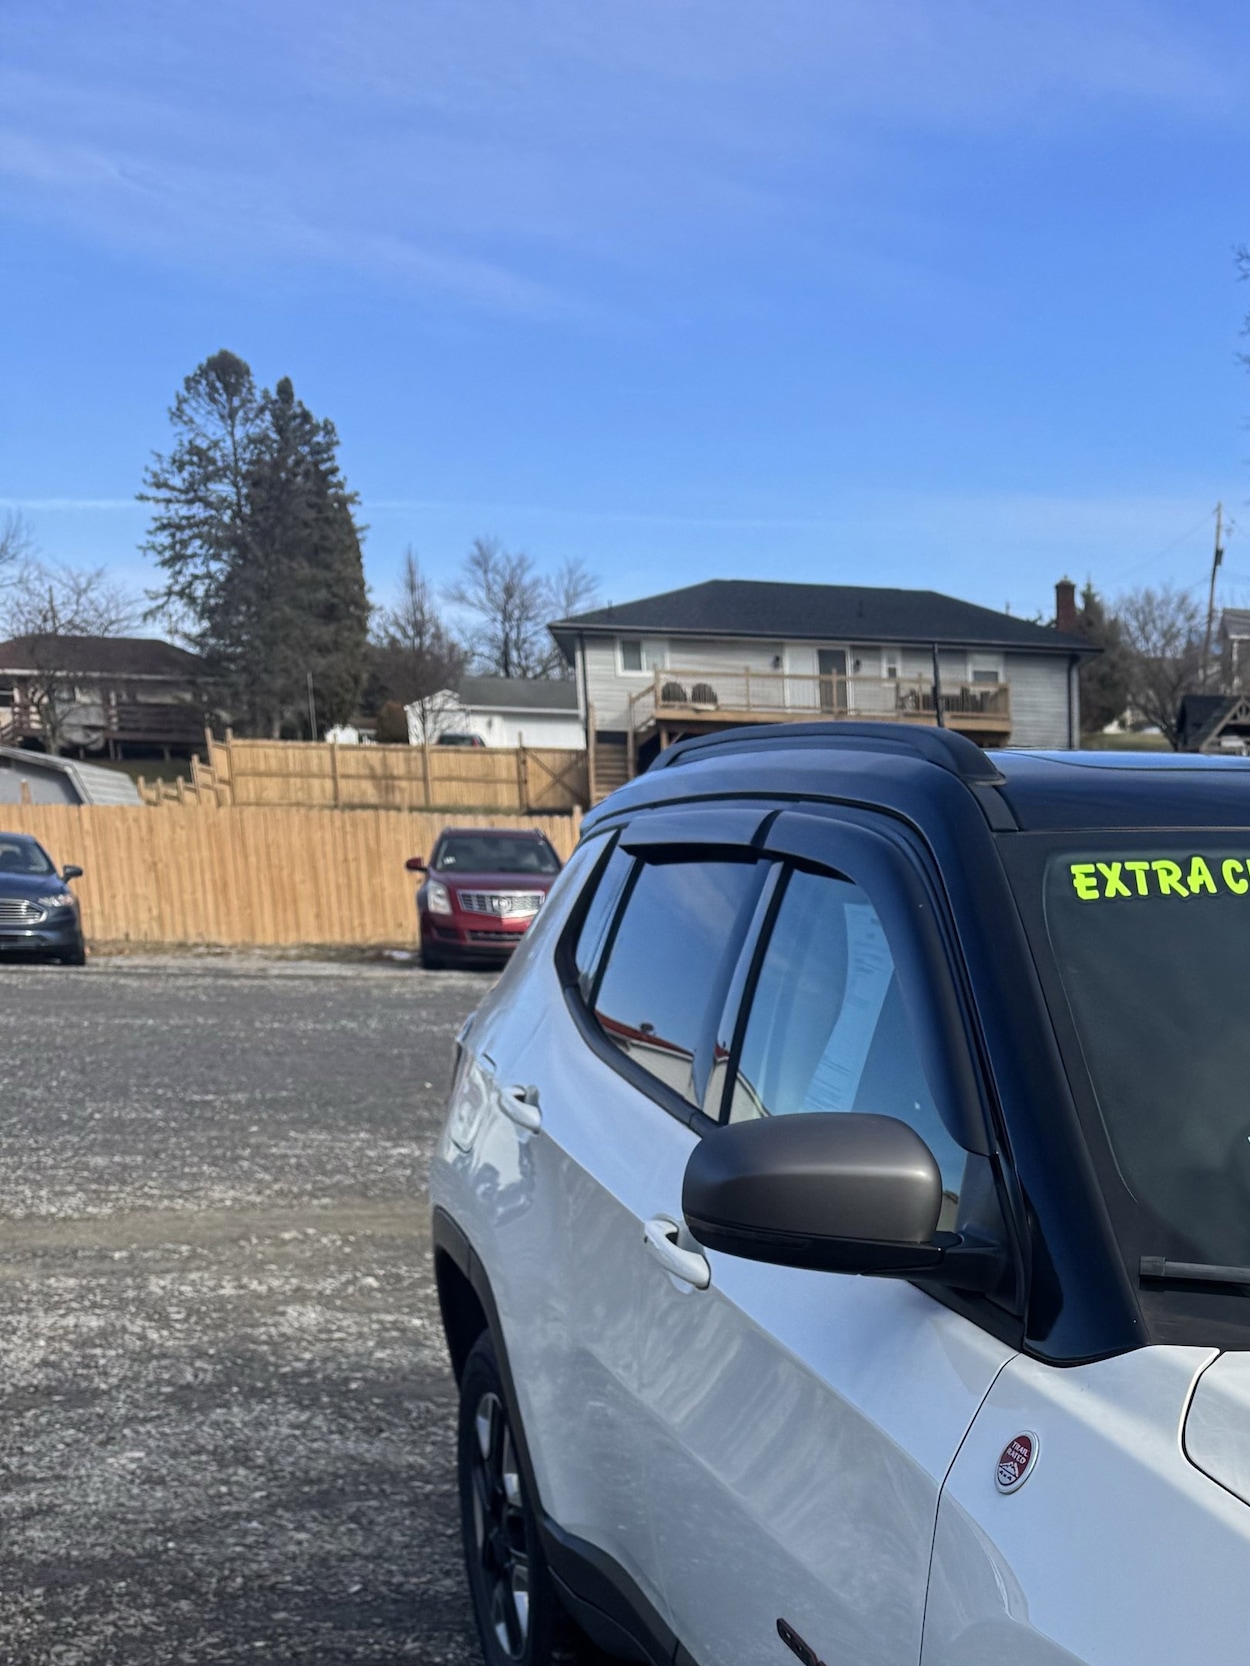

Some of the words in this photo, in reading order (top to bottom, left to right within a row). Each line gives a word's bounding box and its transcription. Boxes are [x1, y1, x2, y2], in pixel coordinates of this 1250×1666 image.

[1070, 856, 1218, 900] EXTRA
[1006, 1447, 1027, 1464] RATED
[1011, 1441, 1029, 1458] TRAIL
